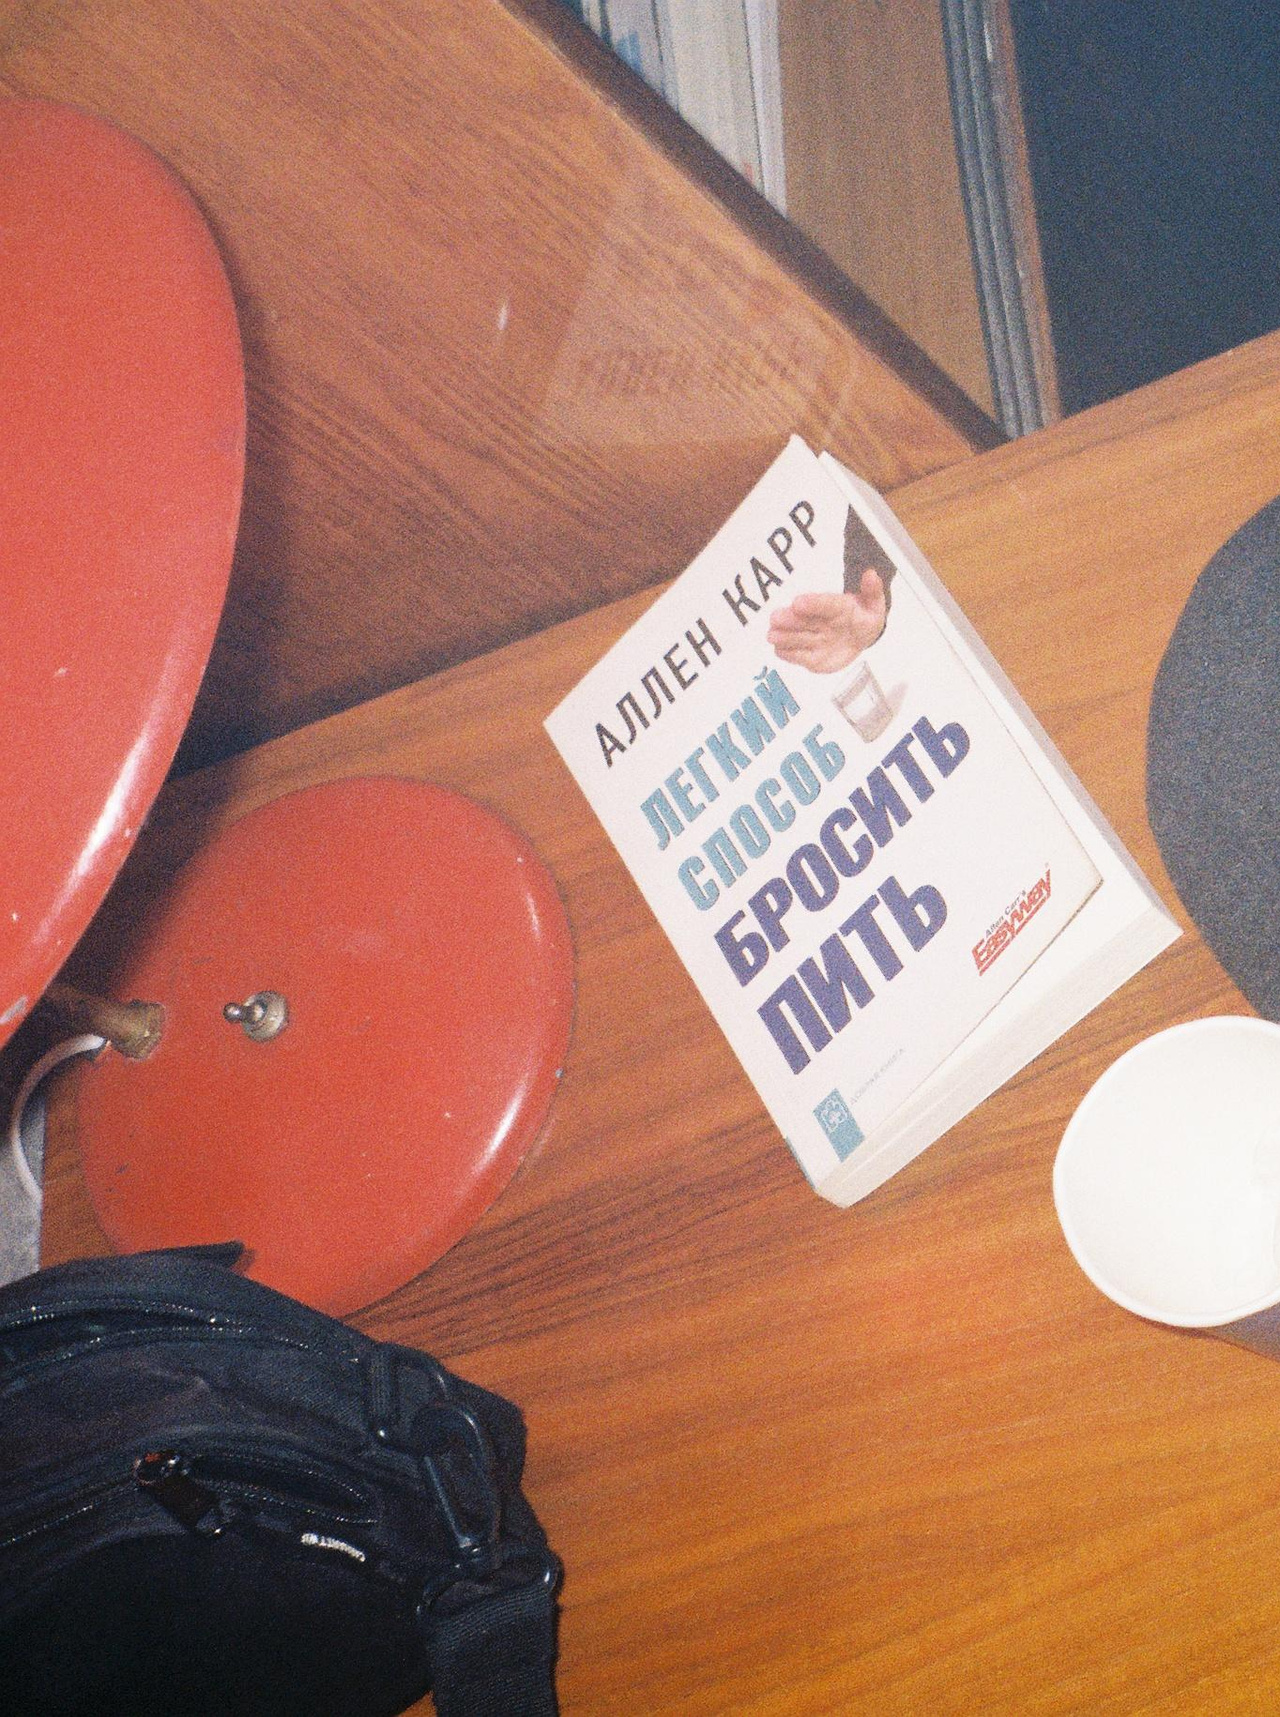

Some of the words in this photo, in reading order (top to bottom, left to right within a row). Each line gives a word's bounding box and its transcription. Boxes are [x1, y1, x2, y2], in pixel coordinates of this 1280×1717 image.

[595, 618, 722, 768] АЛЛЕН
[722, 500, 817, 627] КАРР
[640, 666, 800, 851] ЛЕГКИЙ
[677, 723, 846, 911] СПОСОБ
[713, 716, 970, 988] БРОСИТЬ
[756, 875, 948, 1075] ПИТЬ
